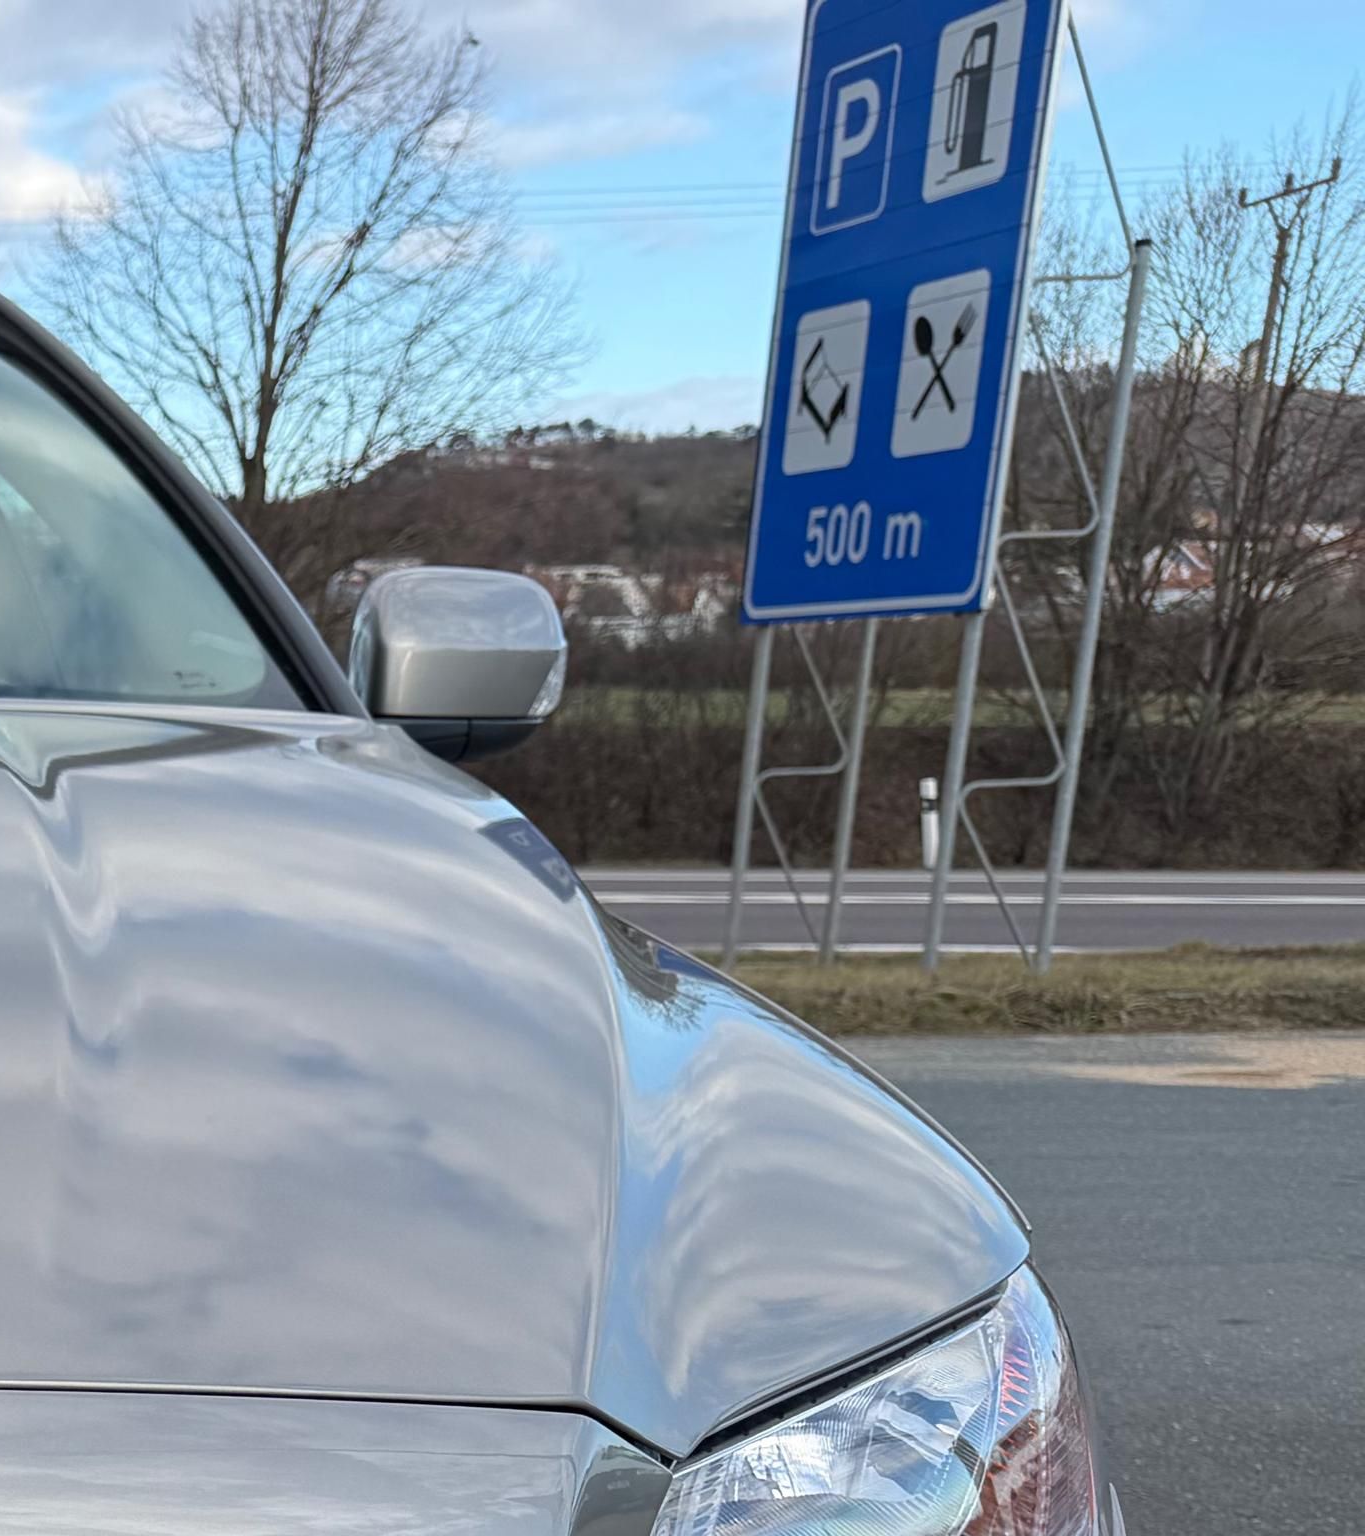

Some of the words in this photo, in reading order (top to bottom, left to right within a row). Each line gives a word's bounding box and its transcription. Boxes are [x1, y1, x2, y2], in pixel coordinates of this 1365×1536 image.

[826, 78, 881, 210] P
[804, 500, 871, 568] 500
[882, 511, 922, 560] m
